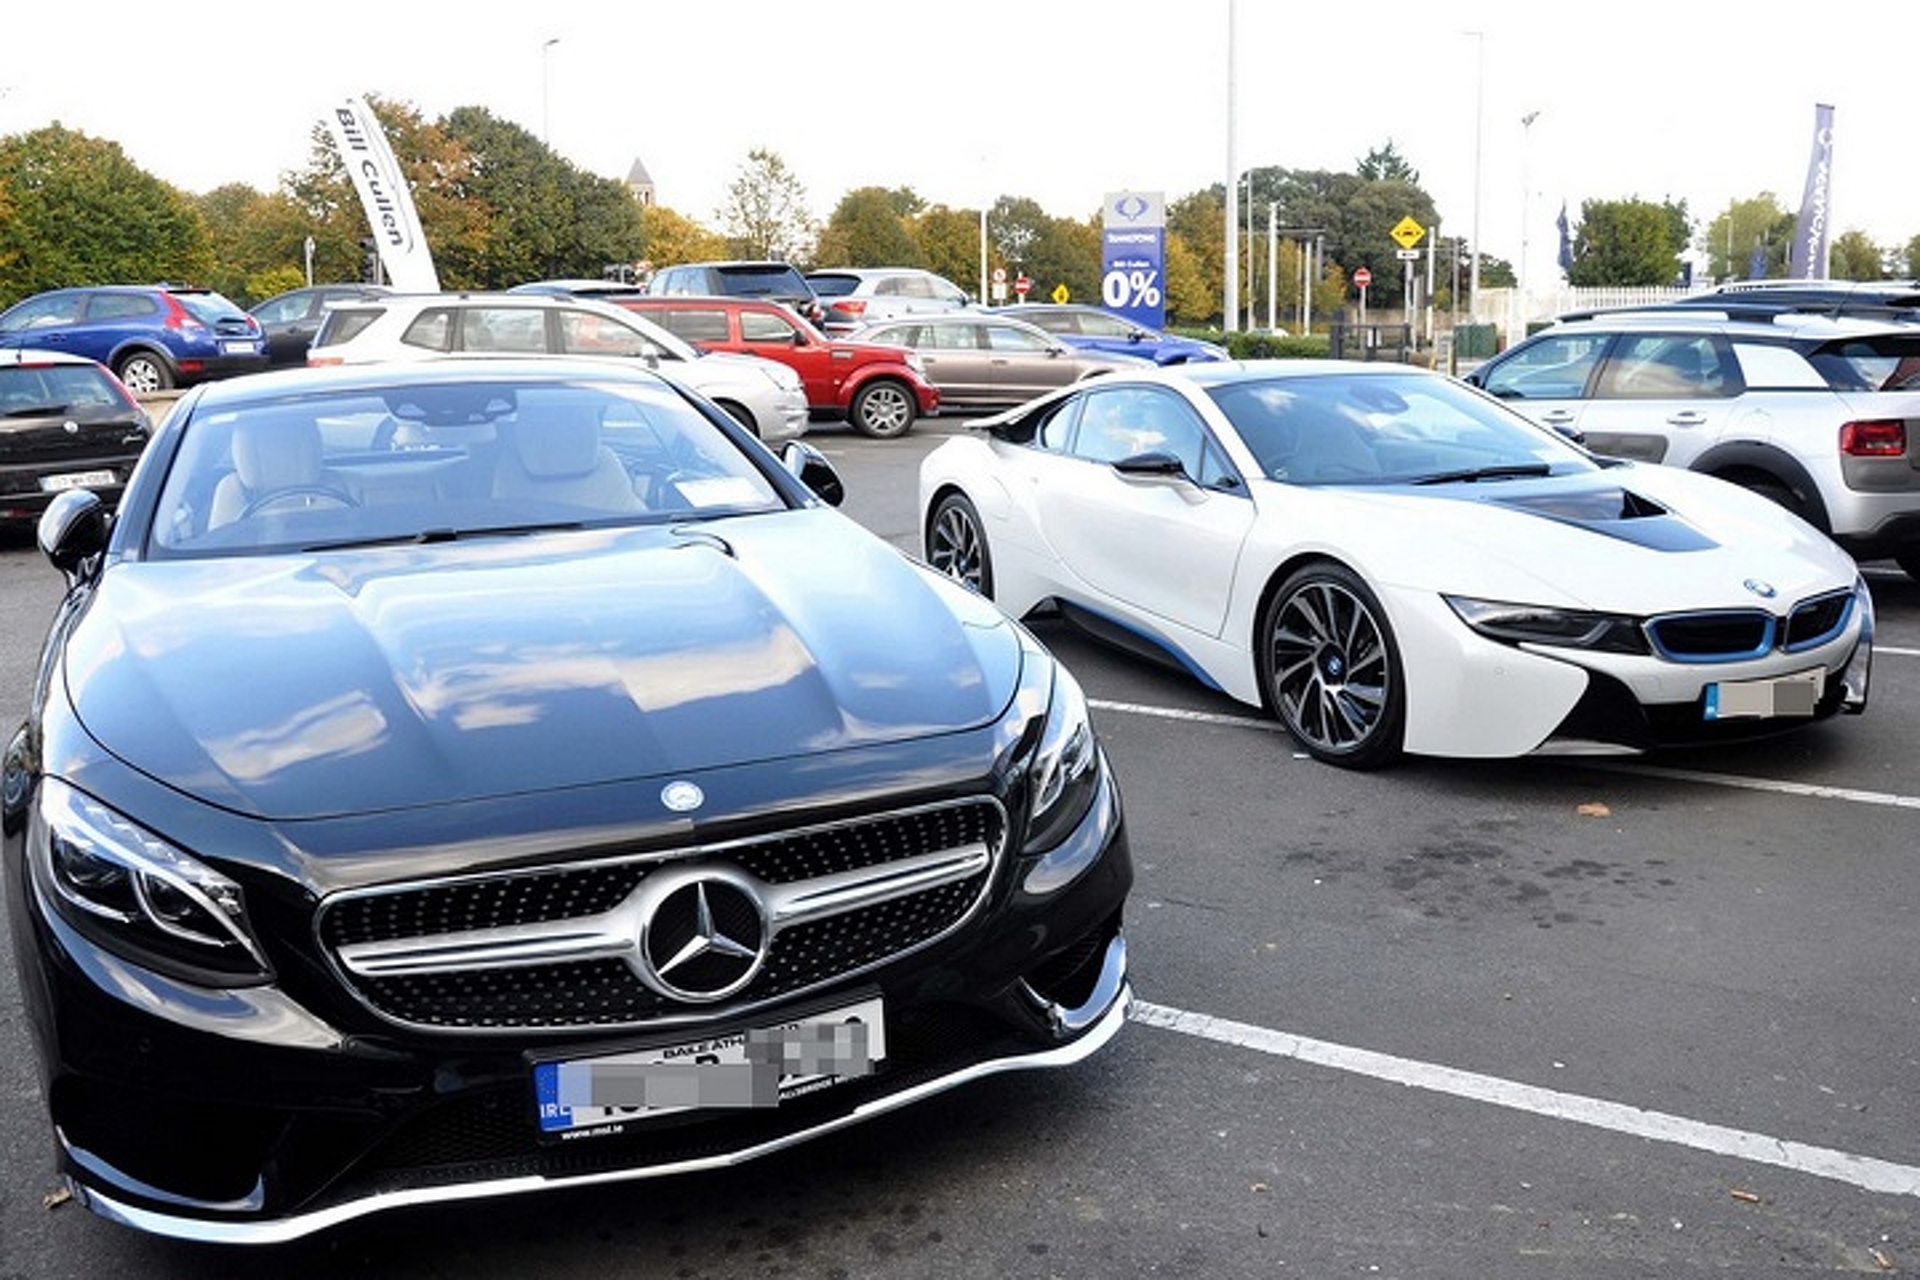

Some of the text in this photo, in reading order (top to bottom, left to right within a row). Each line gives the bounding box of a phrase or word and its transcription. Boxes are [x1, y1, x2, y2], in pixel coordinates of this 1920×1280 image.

[336, 108, 404, 246] Bill Cullen
[1102, 269, 1161, 308] 0%
[540, 1102, 572, 1119] IRL
